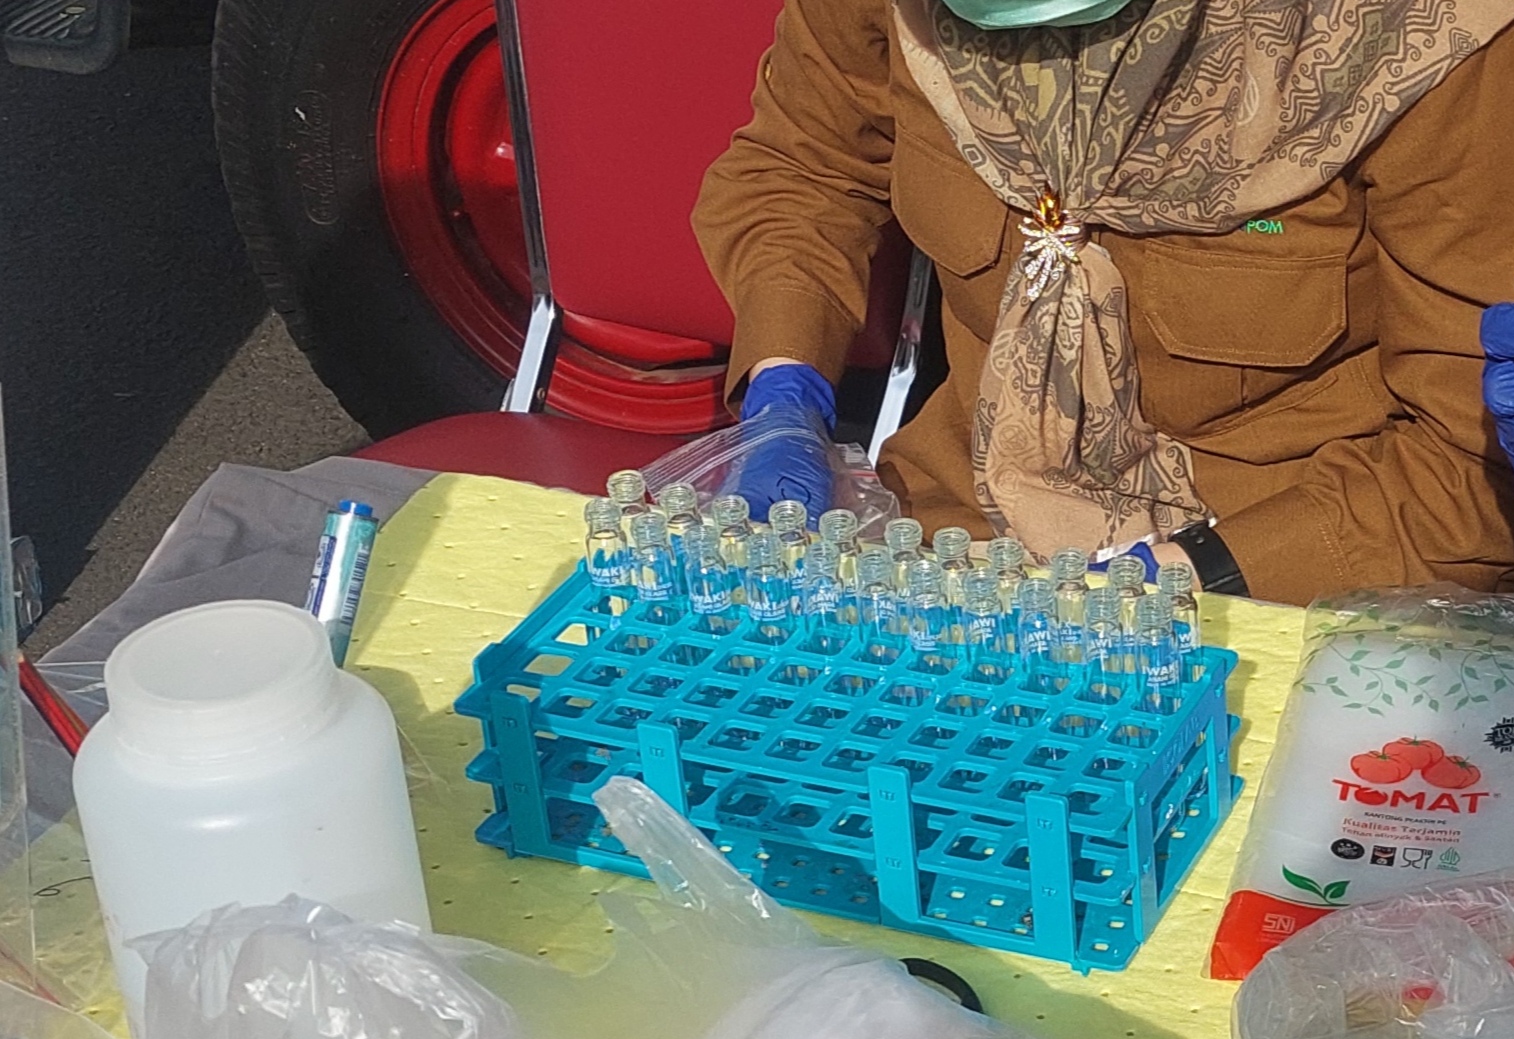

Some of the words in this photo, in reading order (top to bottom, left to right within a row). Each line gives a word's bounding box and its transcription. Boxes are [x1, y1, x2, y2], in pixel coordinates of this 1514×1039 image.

[1246, 220, 1284, 235] POM
[1331, 778, 1490, 814] TOMAT
[1342, 817, 1398, 832] Kualitas
[1401, 824, 1462, 836] Terjamin
[1261, 912, 1296, 935] SNI
